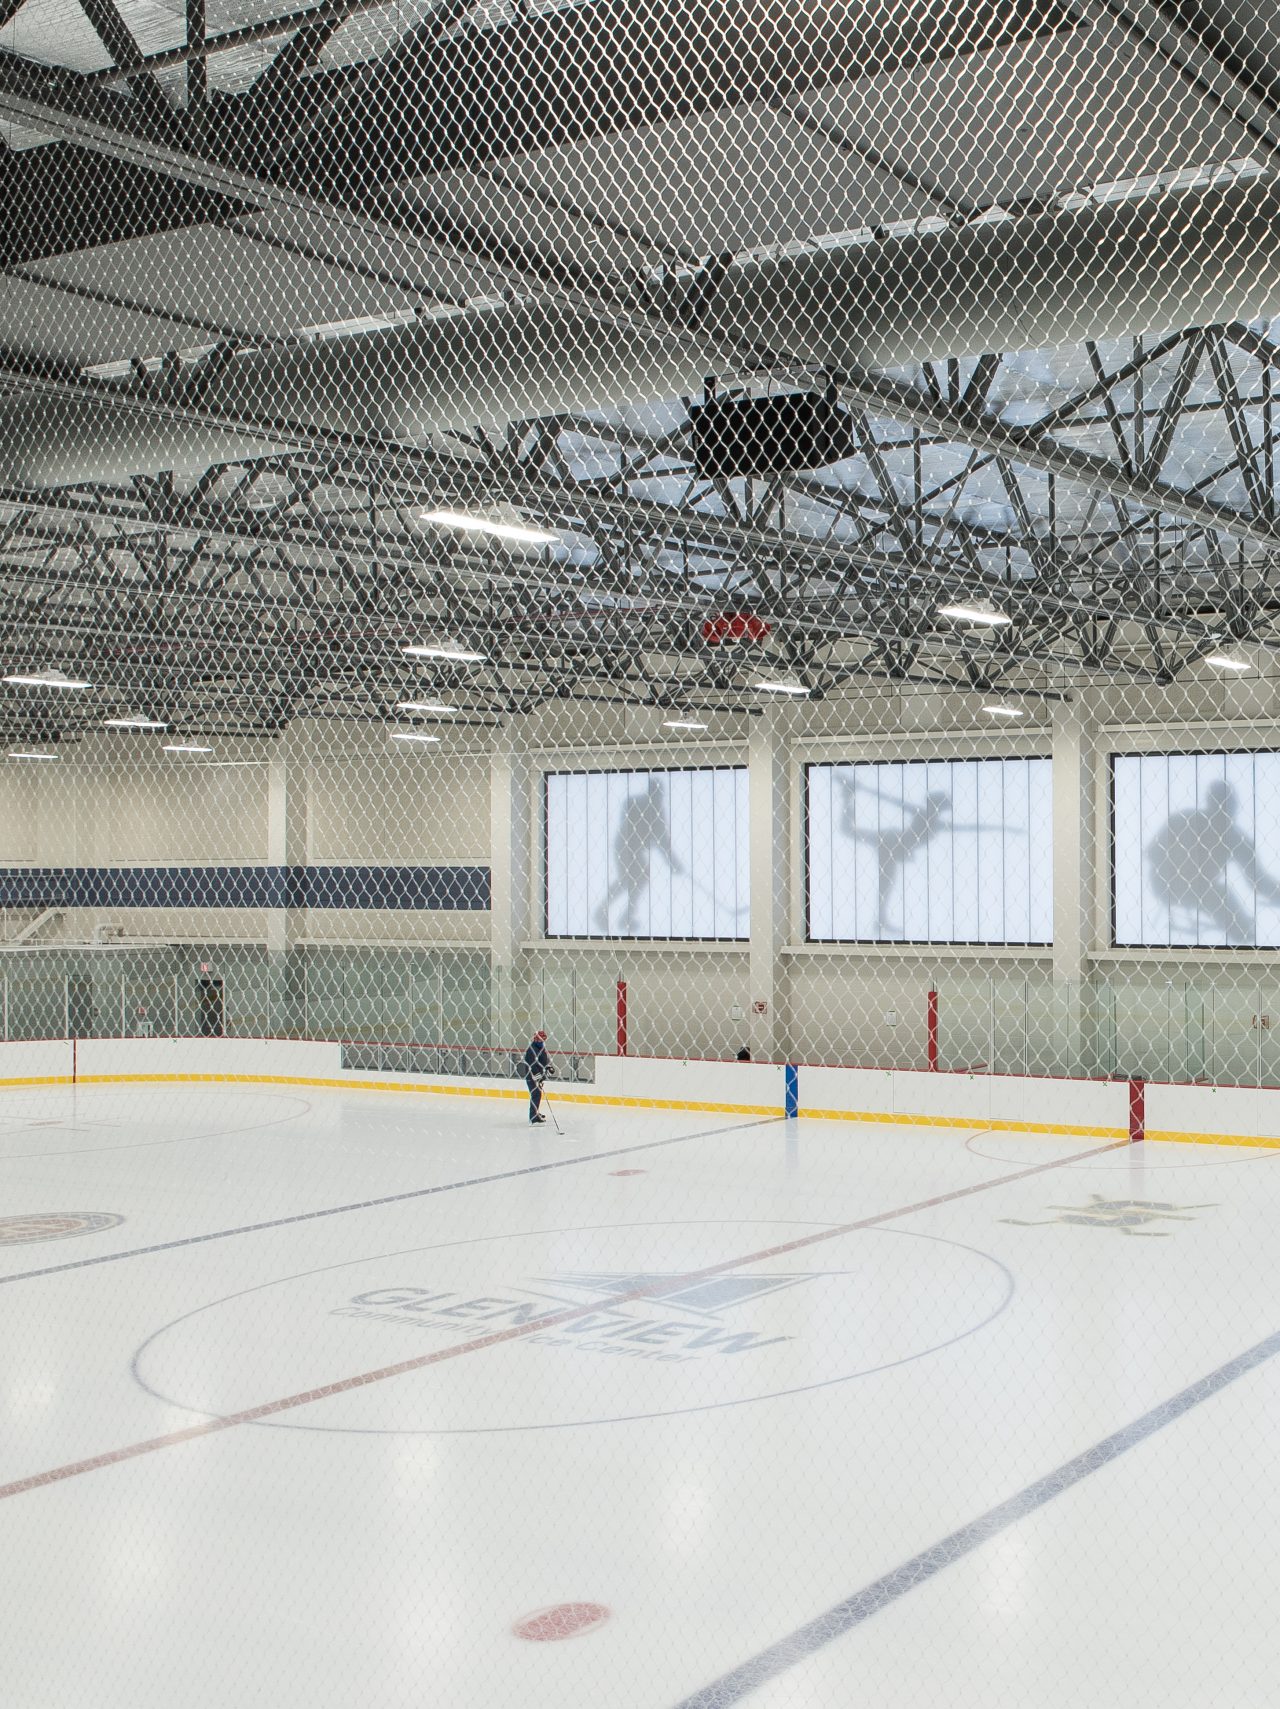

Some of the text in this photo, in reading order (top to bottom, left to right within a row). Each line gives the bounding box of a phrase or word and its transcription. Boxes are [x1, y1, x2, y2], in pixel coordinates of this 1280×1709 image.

[328, 1306, 702, 1363] Community Ice Center
[350, 1286, 797, 1354] GLENVIEW
